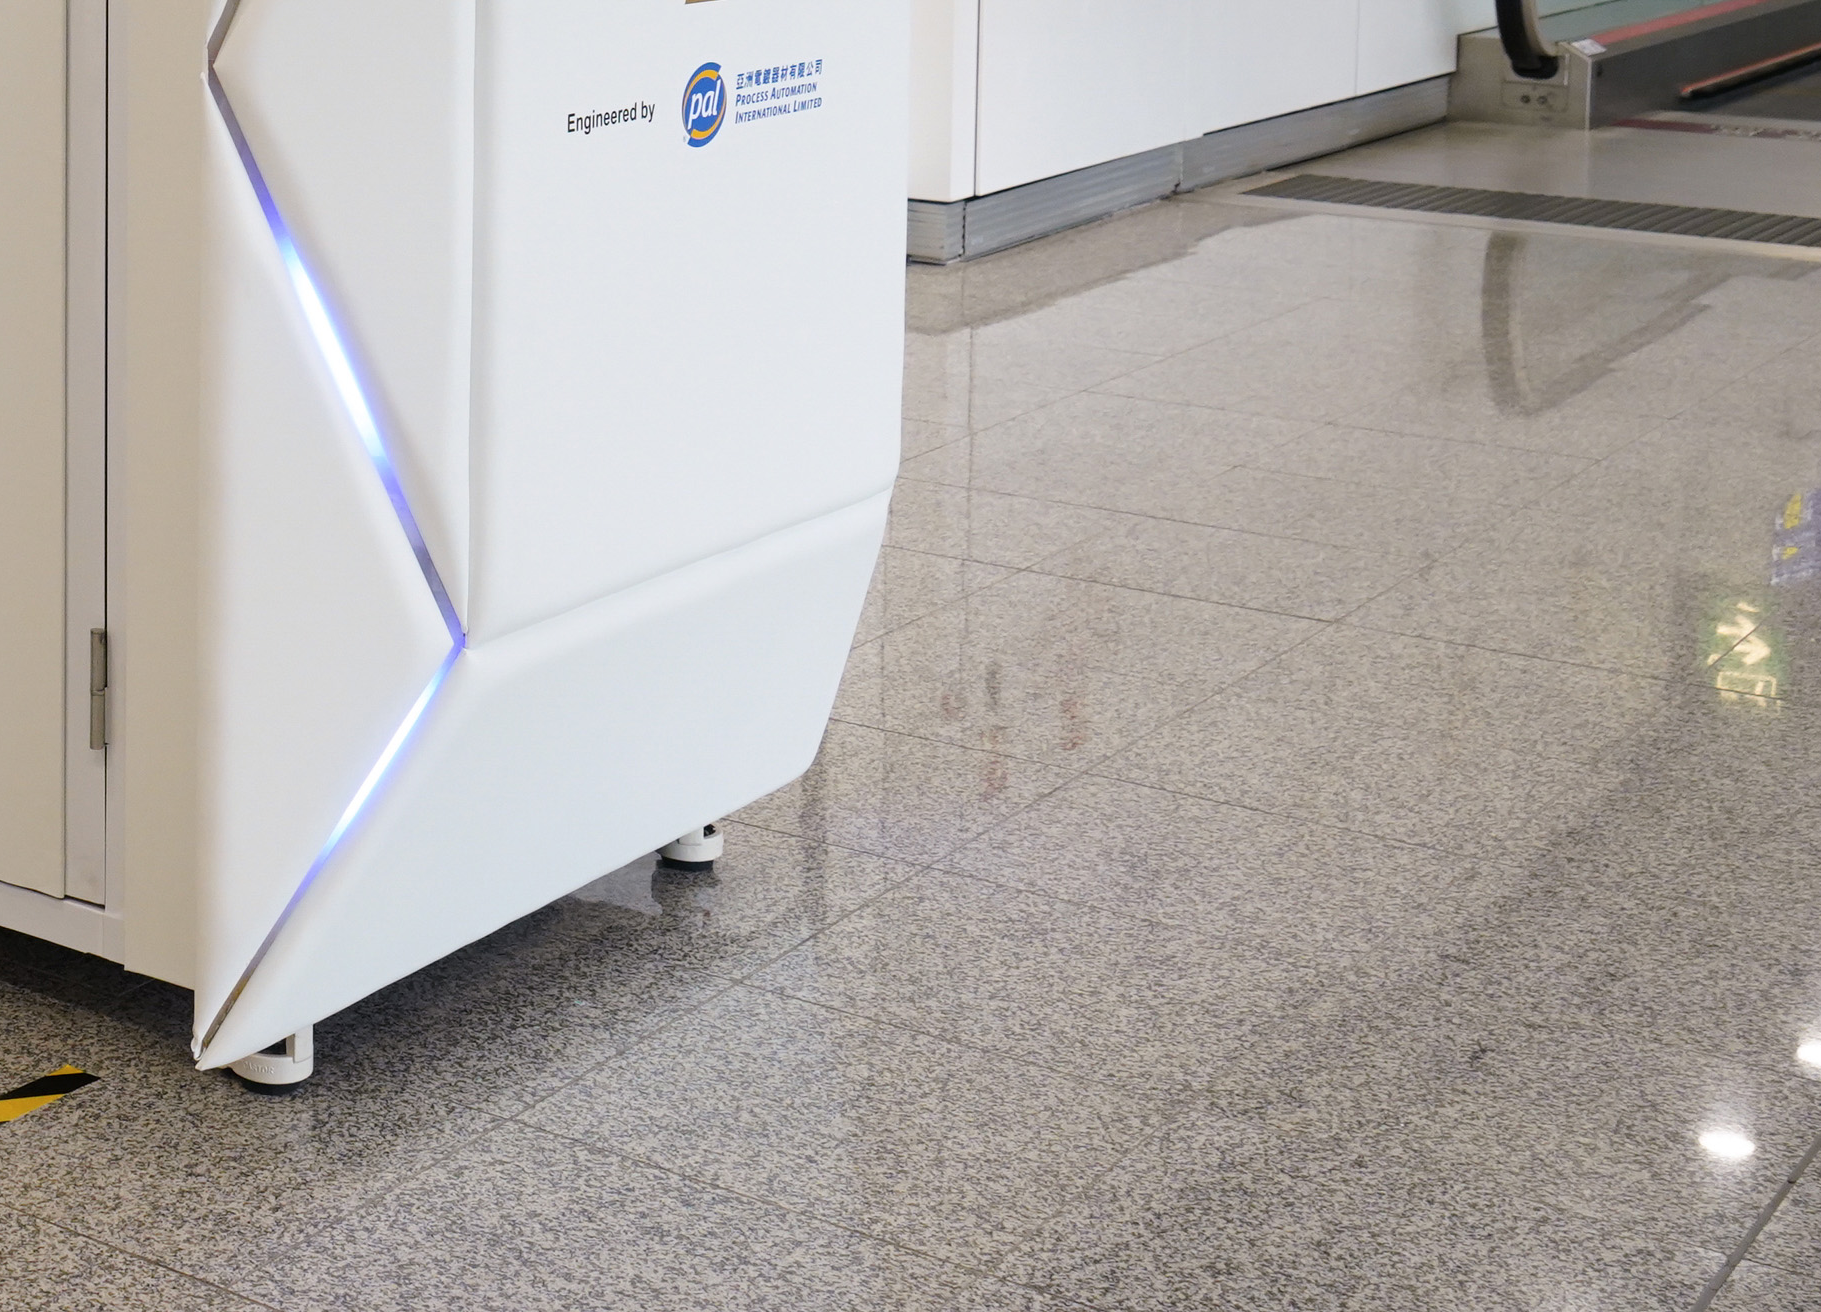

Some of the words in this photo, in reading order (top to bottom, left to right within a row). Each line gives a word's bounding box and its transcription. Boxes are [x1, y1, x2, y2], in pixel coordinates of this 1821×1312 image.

[567, 103, 637, 135] Engineered
[641, 101, 656, 122] by
[687, 79, 722, 131] pal
